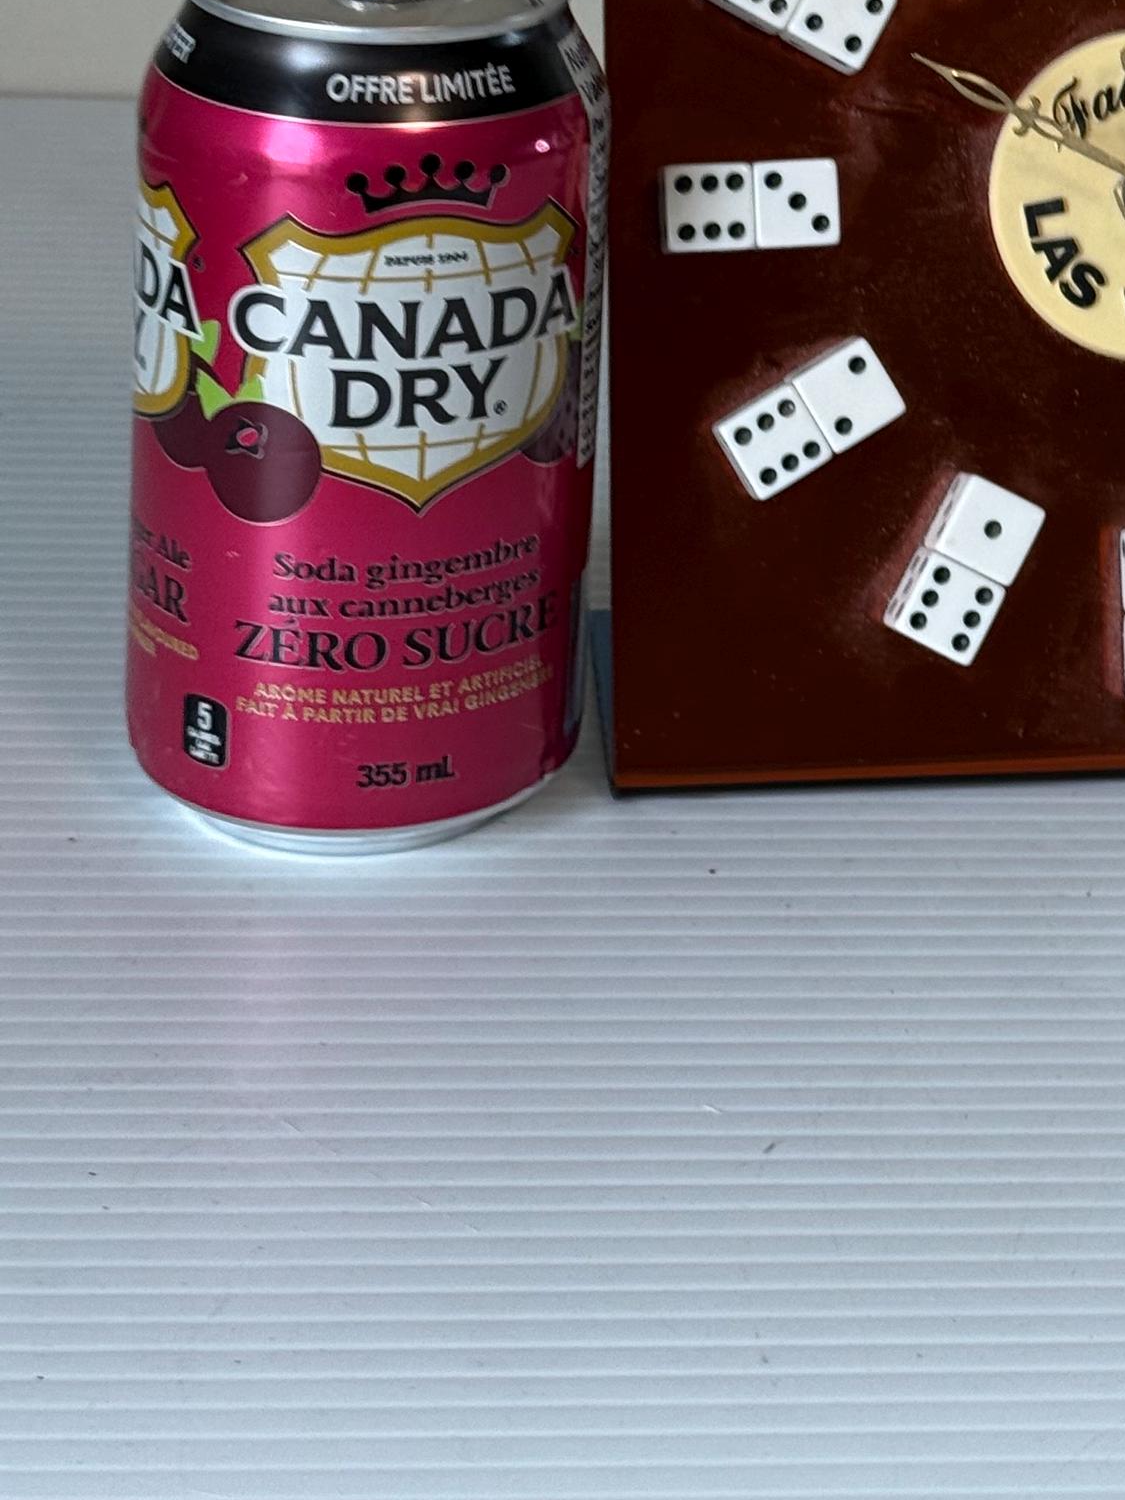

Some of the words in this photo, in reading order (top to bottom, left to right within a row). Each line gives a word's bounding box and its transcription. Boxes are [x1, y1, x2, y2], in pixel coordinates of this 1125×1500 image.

[325, 71, 415, 105] OFFRE
[420, 62, 516, 104] LIMITÉE
[1023, 197, 1107, 309] LAS
[233, 272, 577, 360] CANADA
[330, 357, 507, 428] DRY
[273, 551, 358, 584] Soda
[365, 534, 541, 590] gingembre
[269, 594, 333, 619] aux
[338, 568, 541, 619] canneberges
[234, 617, 389, 673] ZÉRO
[402, 592, 558, 670] SUCRE
[197, 701, 213, 731] 5
[235, 695, 279, 718] FAIT
[302, 706, 377, 724] PARTIR
[380, 706, 408, 724] DE
[412, 700, 460, 721] VRAI
[332, 684, 424, 706] NATUREL
[429, 680, 455, 699] ET
[356, 761, 408, 789] 355
[415, 755, 456, 783] mL
